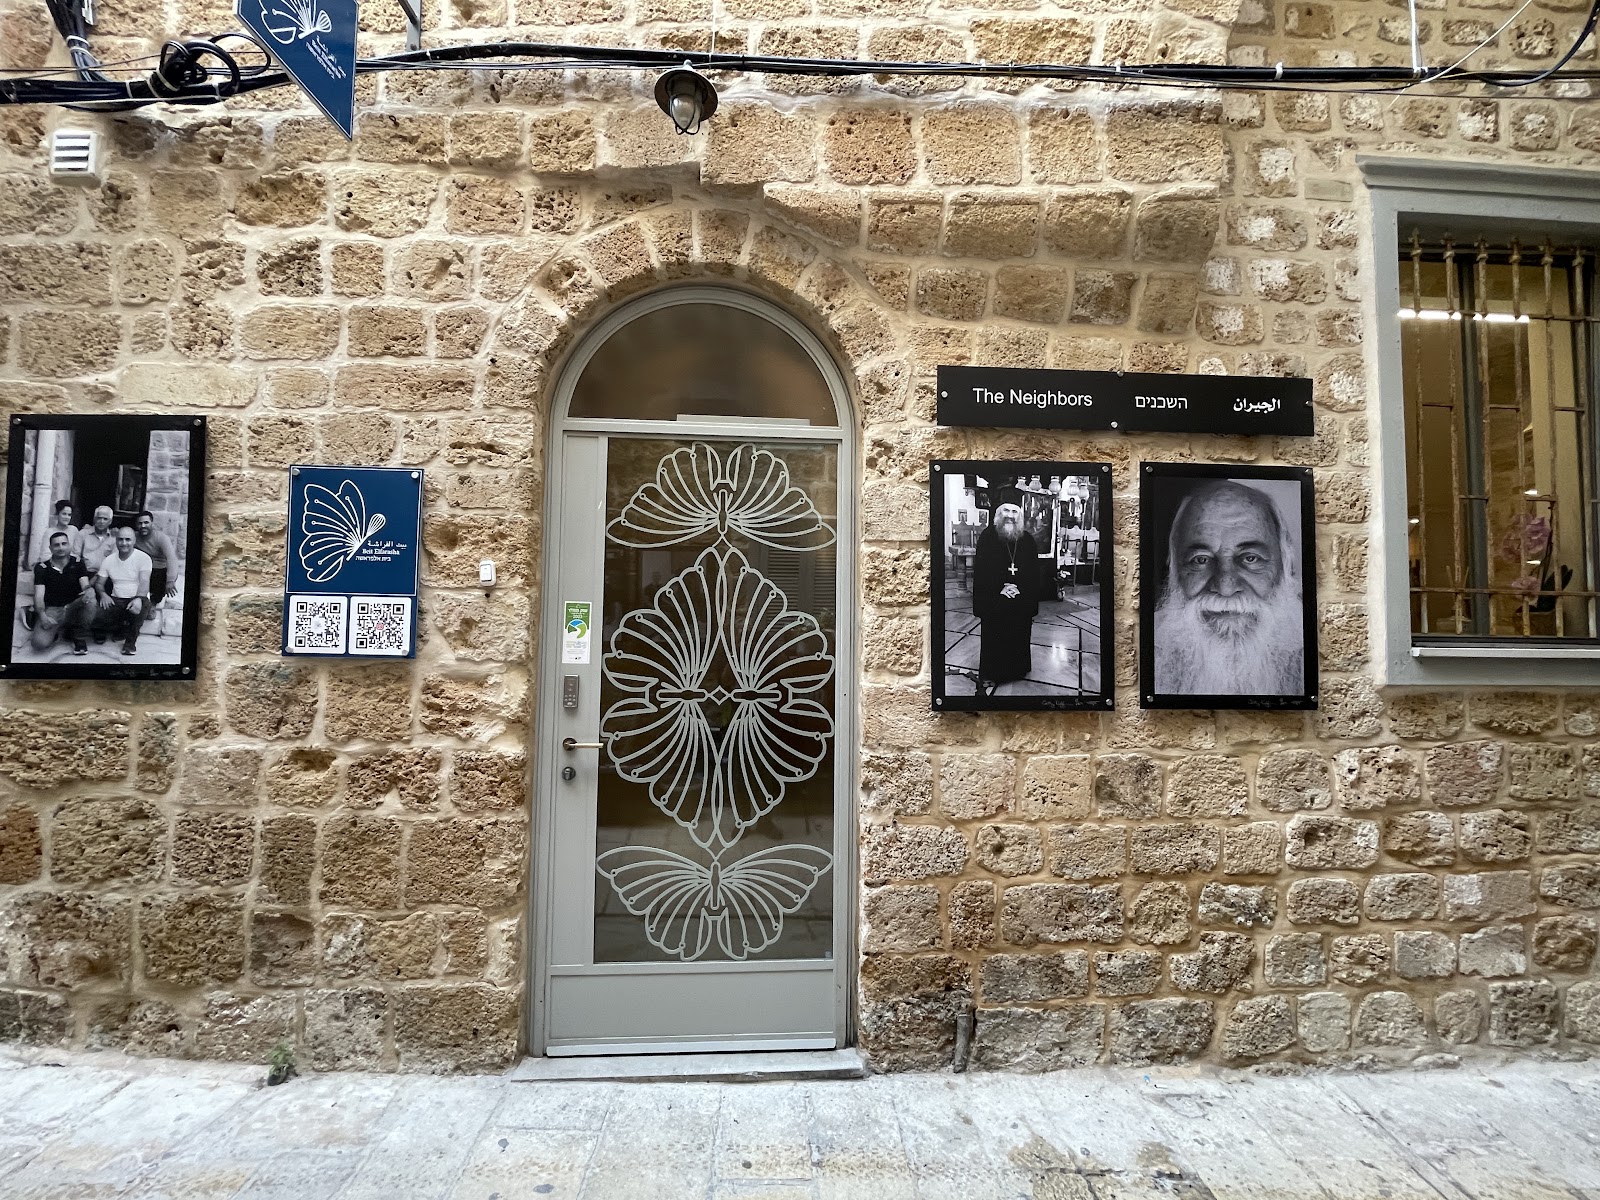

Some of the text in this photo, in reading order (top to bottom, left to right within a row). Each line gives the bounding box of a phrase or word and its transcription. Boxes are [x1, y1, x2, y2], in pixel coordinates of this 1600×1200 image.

[972, 387, 1093, 409] The Neighbors
[1135, 395, 1188, 410] השכנים
[1233, 397, 1281, 414] الجيران
